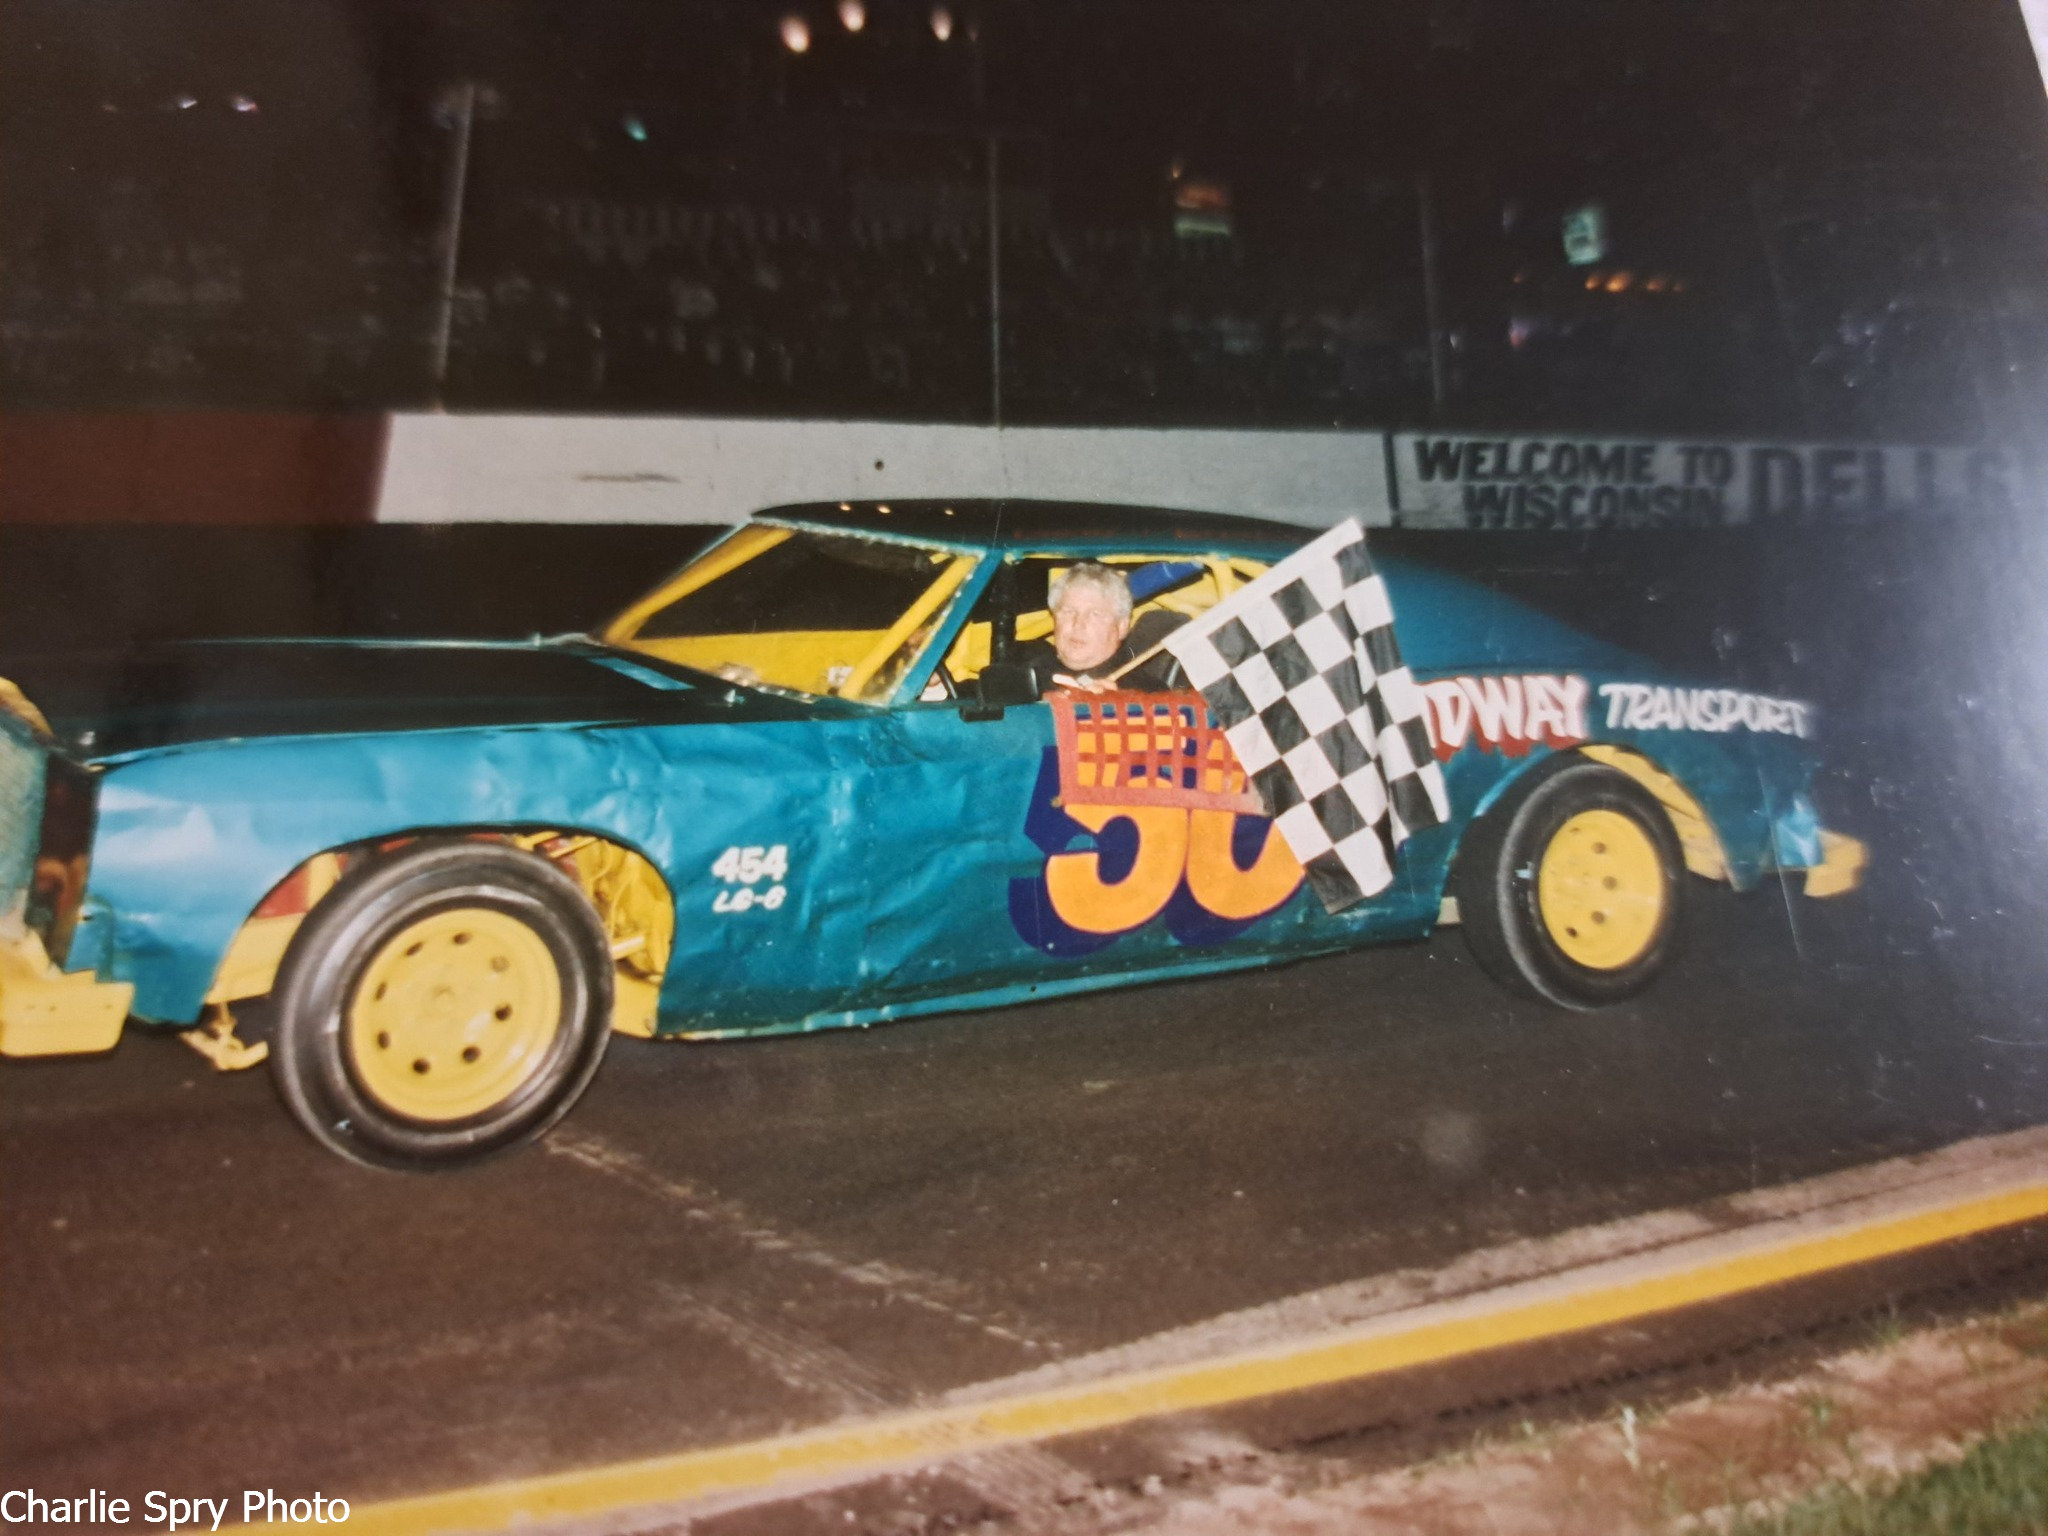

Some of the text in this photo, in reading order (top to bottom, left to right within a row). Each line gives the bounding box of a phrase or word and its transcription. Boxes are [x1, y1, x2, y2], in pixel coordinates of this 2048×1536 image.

[1413, 441, 1734, 487] WELCOME TO
[1461, 484, 1724, 530] WISCONSIN
[1598, 683, 1808, 739] TRANSPORT
[711, 844, 789, 884] 454
